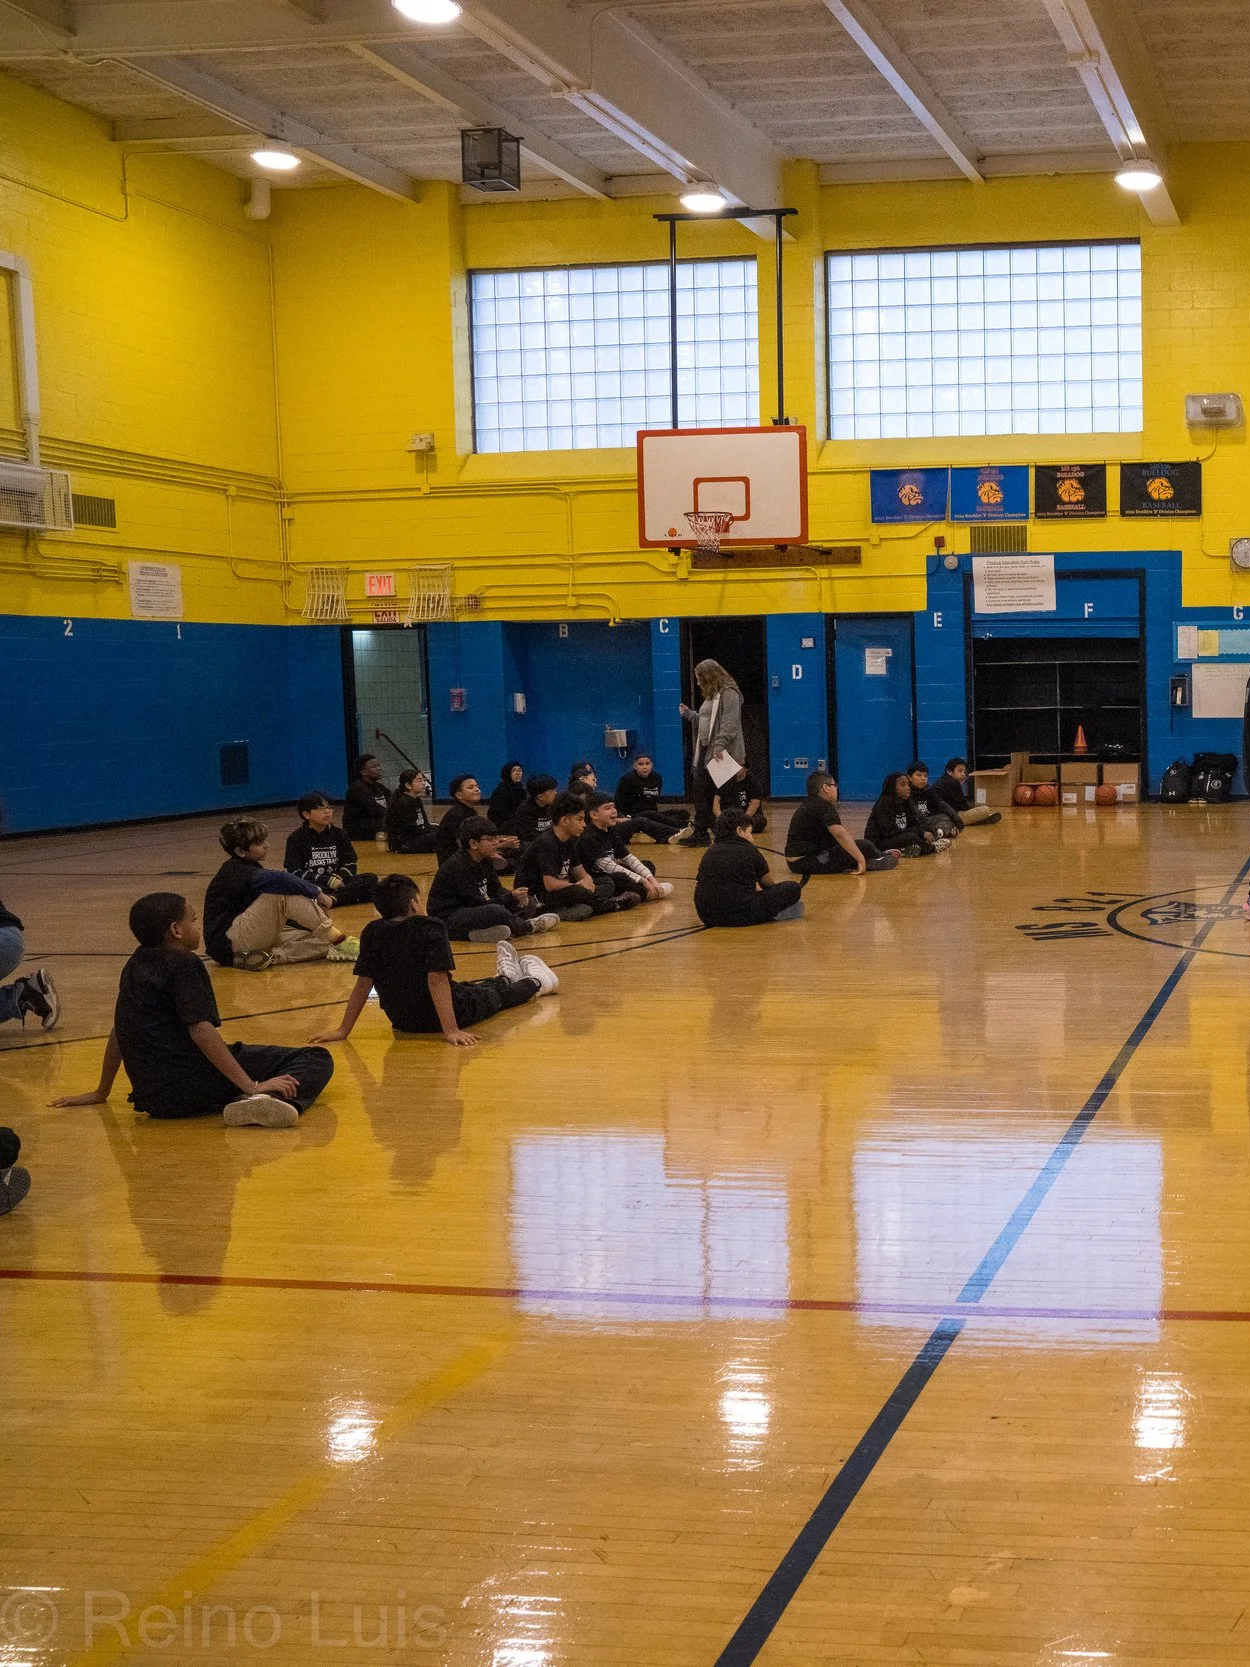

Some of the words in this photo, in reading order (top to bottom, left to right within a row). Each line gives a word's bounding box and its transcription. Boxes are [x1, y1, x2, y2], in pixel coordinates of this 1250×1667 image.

[369, 575, 392, 594] EXIT
[1084, 602, 1094, 618] F
[1233, 605, 1244, 620] G
[64, 619, 73, 636] 2
[659, 619, 669, 633] C
[933, 612, 942, 628] E
[559, 624, 568, 638] B
[791, 664, 802, 680] D
[311, 850, 337, 860] BROOKLYN
[1031, 891, 1145, 911] 821
